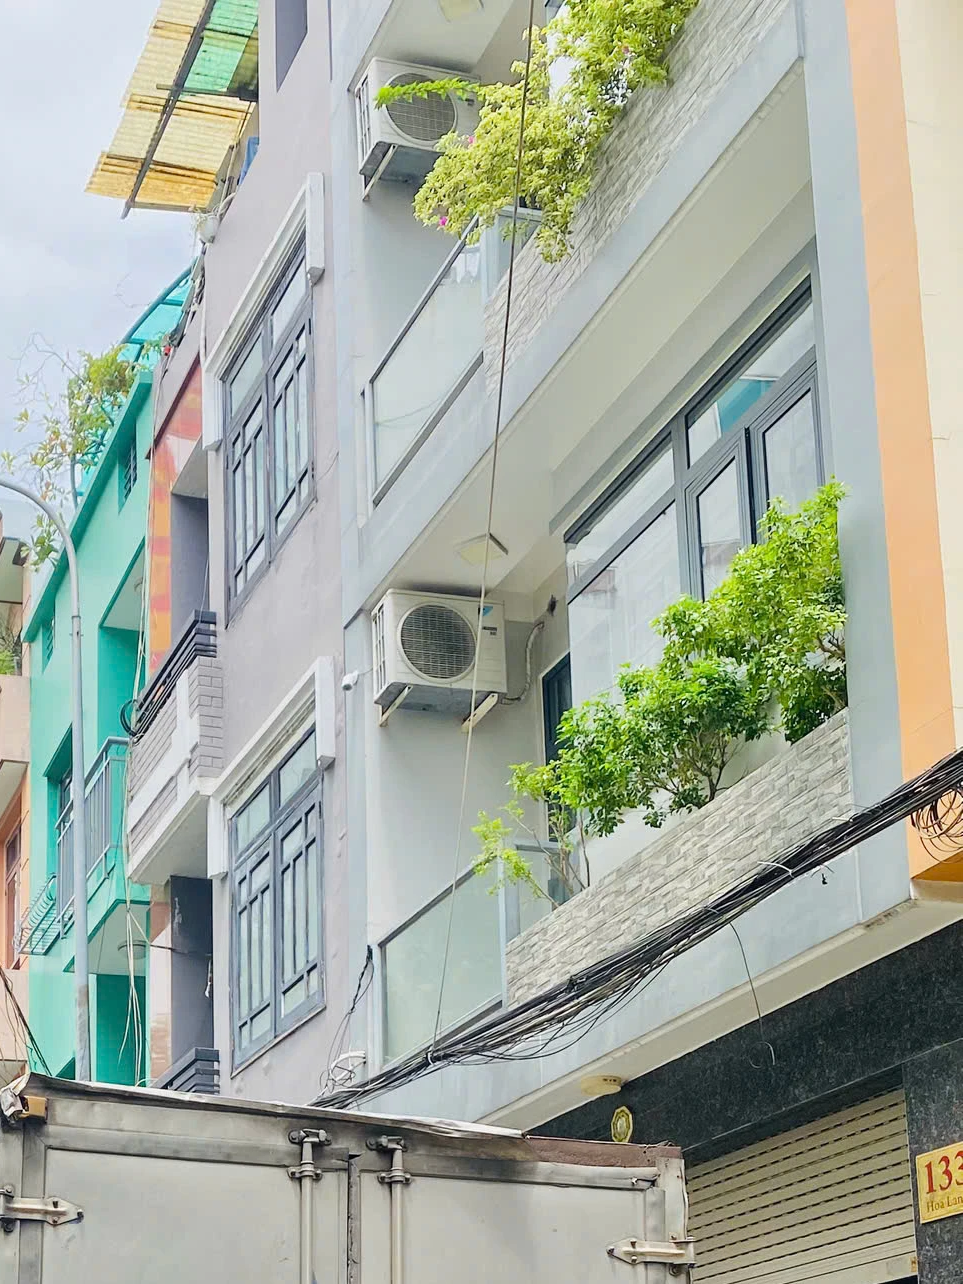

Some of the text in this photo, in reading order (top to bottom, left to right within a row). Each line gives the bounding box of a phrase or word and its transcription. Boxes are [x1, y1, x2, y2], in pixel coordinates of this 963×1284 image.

[924, 1150, 963, 1195] 133
[926, 1195, 963, 1213] Hoa Lan
